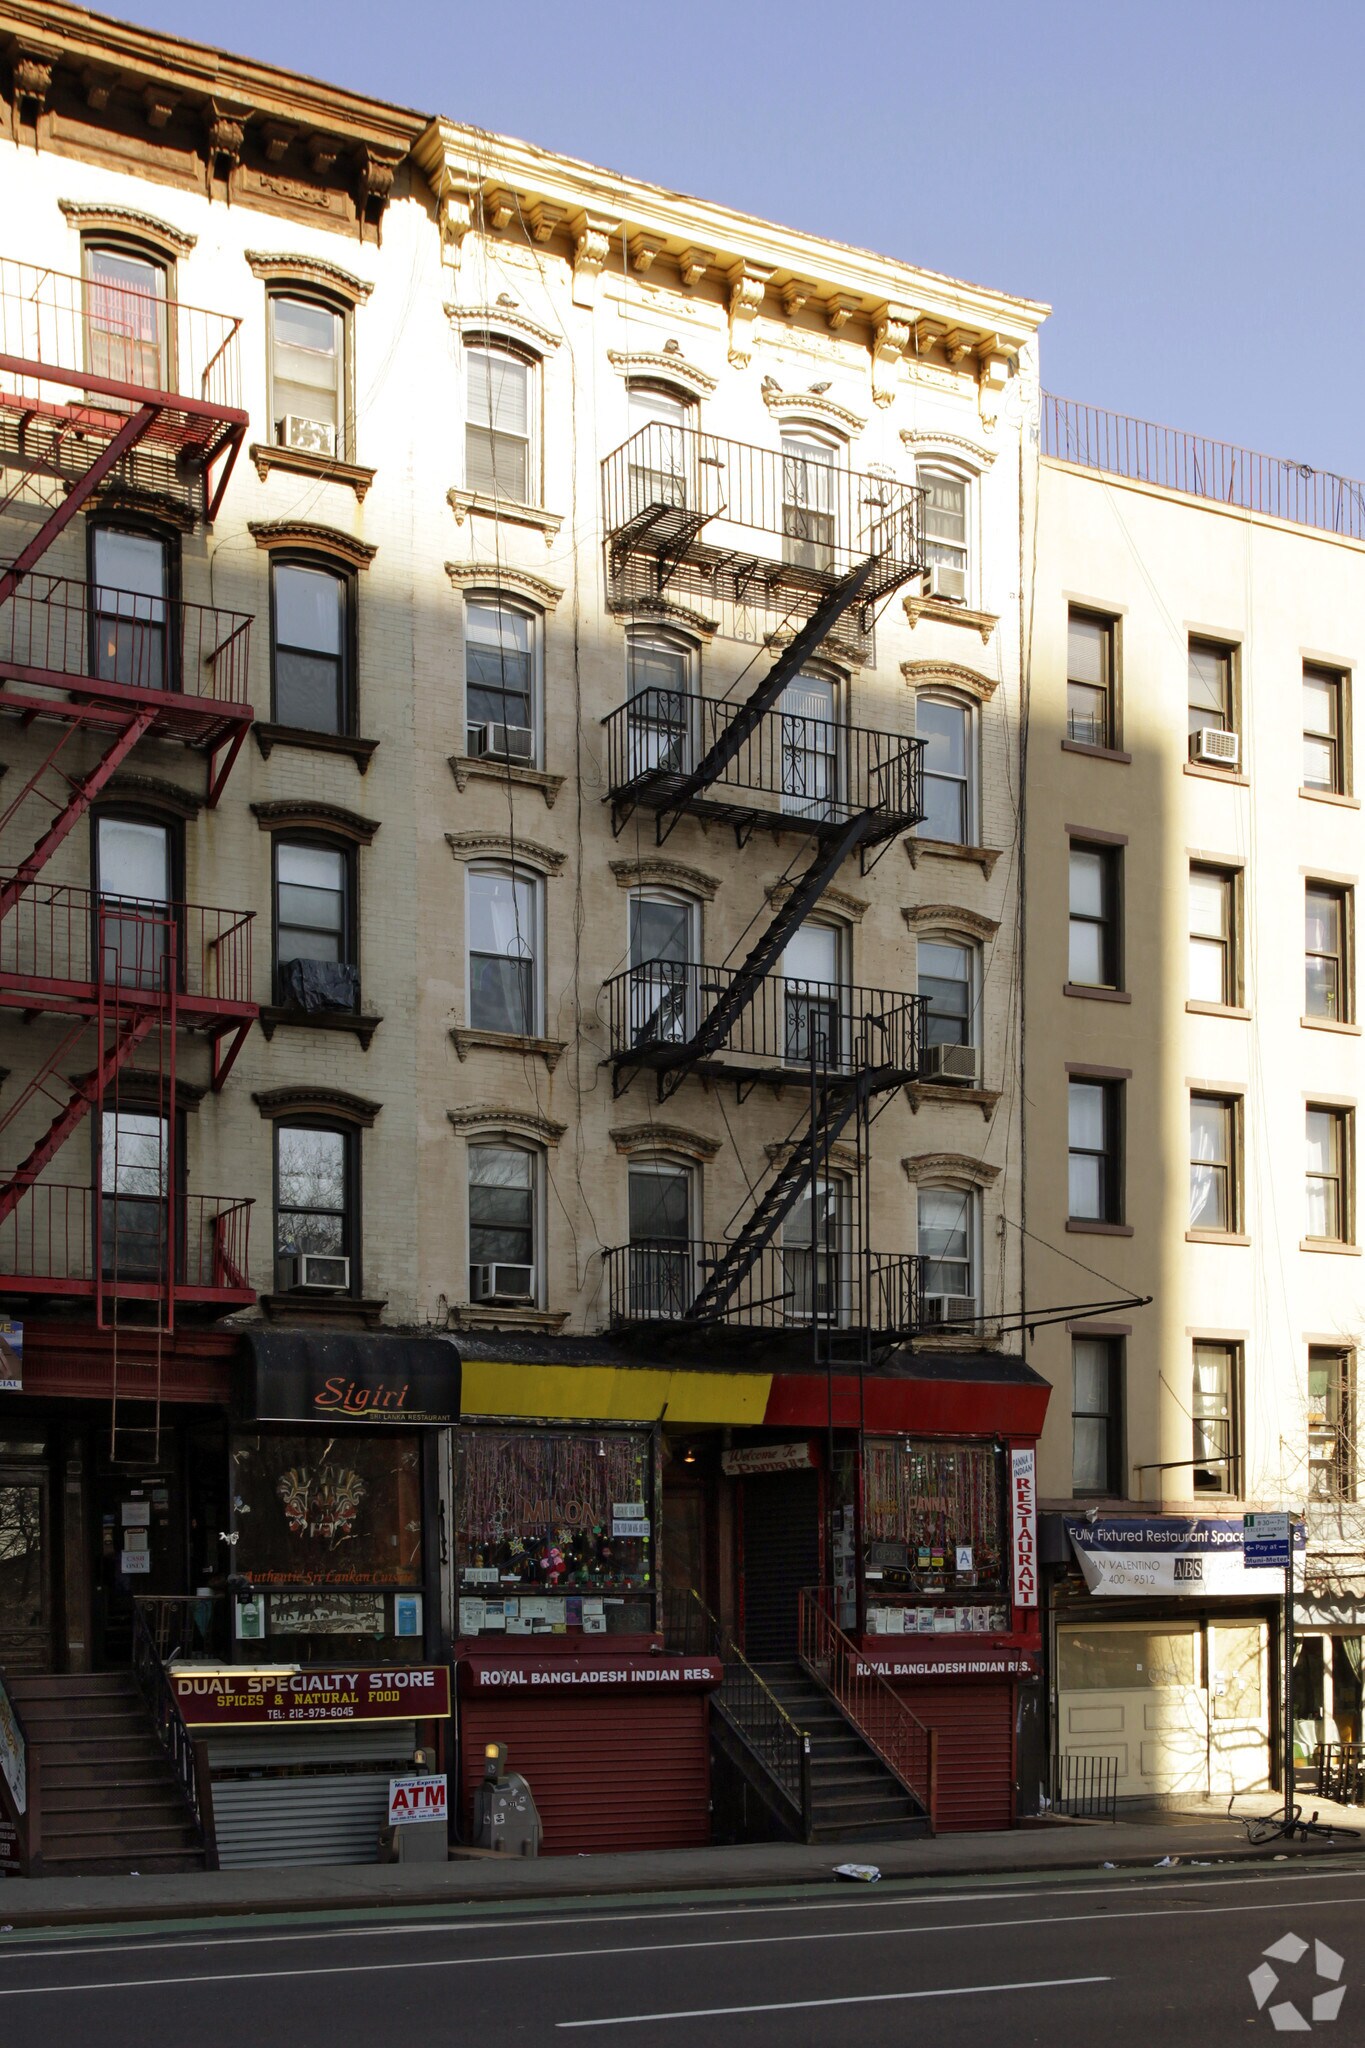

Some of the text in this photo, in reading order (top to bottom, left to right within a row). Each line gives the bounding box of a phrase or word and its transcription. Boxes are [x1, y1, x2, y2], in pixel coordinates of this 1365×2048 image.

[314, 1377, 409, 1412] Sigiri
[728, 1445, 796, 1462] Welcome To
[1013, 1457, 1029, 1469] PANNA
[1013, 1465, 1033, 1478] INDIAN
[523, 1500, 601, 1526] MILON
[1016, 1478, 1035, 1604] RESTAURANT
[1069, 1528, 1094, 1543] Fully
[1097, 1529, 1143, 1542] Fixtured
[1147, 1530, 1208, 1543] Restaurant
[1255, 1544, 1268, 1552] Pay
[960, 1550, 970, 1564] A
[1109, 1561, 1160, 1571] VALENTINO
[1174, 1559, 1203, 1580] ABS
[325, 1568, 370, 1585] Lankan
[1108, 1574, 1125, 1585] 400
[1133, 1574, 1156, 1585] 9512
[480, 1668, 714, 1685] ROYAL BANGLADESH INDIAN RES.
[856, 1661, 1031, 1676] ROYAL BANGLADESH INDIAN RES.
[178, 1671, 435, 1696] DUAL SPECIALTY STORE
[217, 1690, 400, 1707] SPICES & NATURAL FOOD
[267, 1706, 354, 1720] TEL: 212-979-6045
[391, 1785, 445, 1810] ATM
